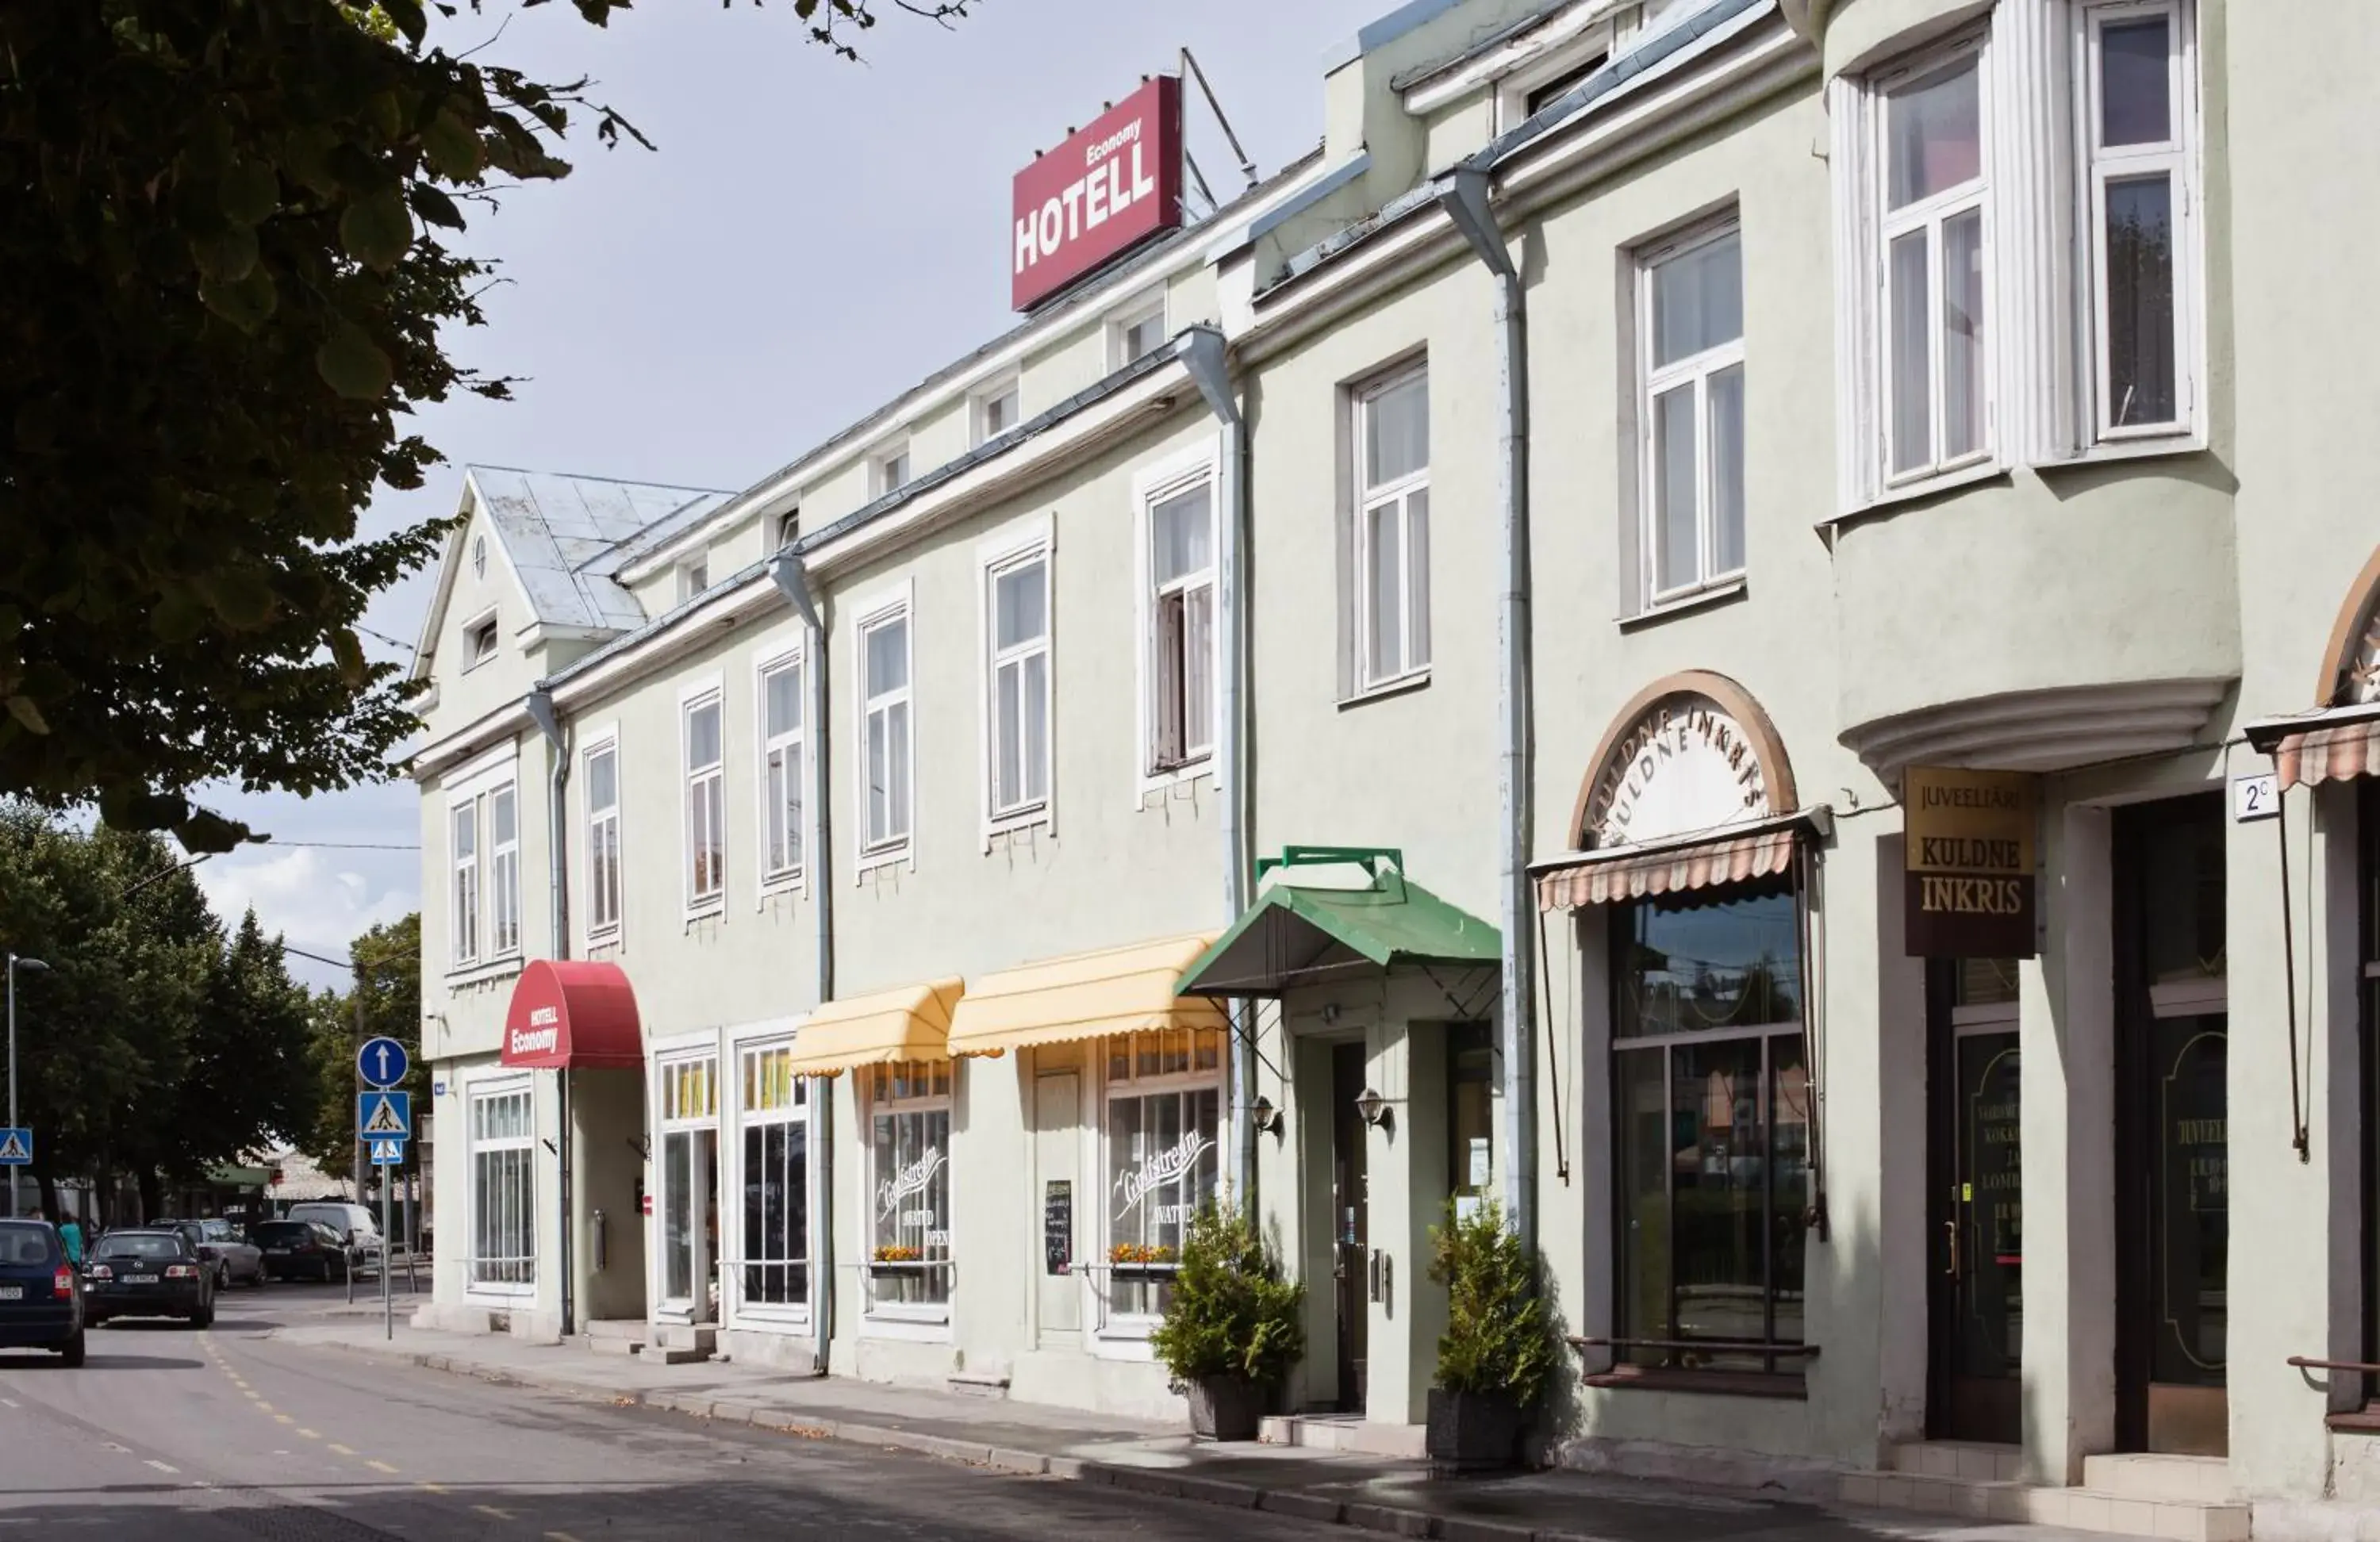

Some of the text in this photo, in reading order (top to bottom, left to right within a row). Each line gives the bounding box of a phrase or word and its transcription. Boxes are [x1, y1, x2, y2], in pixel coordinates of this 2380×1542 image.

[1086, 117, 1142, 167] Economy
[1015, 141, 1154, 274] HOTELL
[1591, 708, 1673, 834] KULDNE
[1921, 785, 2019, 810] JUVEELIÄRI
[1921, 837, 2021, 869] KULDNE
[1921, 876, 2022, 914] INKRIS
[531, 1005, 559, 1026] HOTELL
[511, 1027, 558, 1053] Economy
